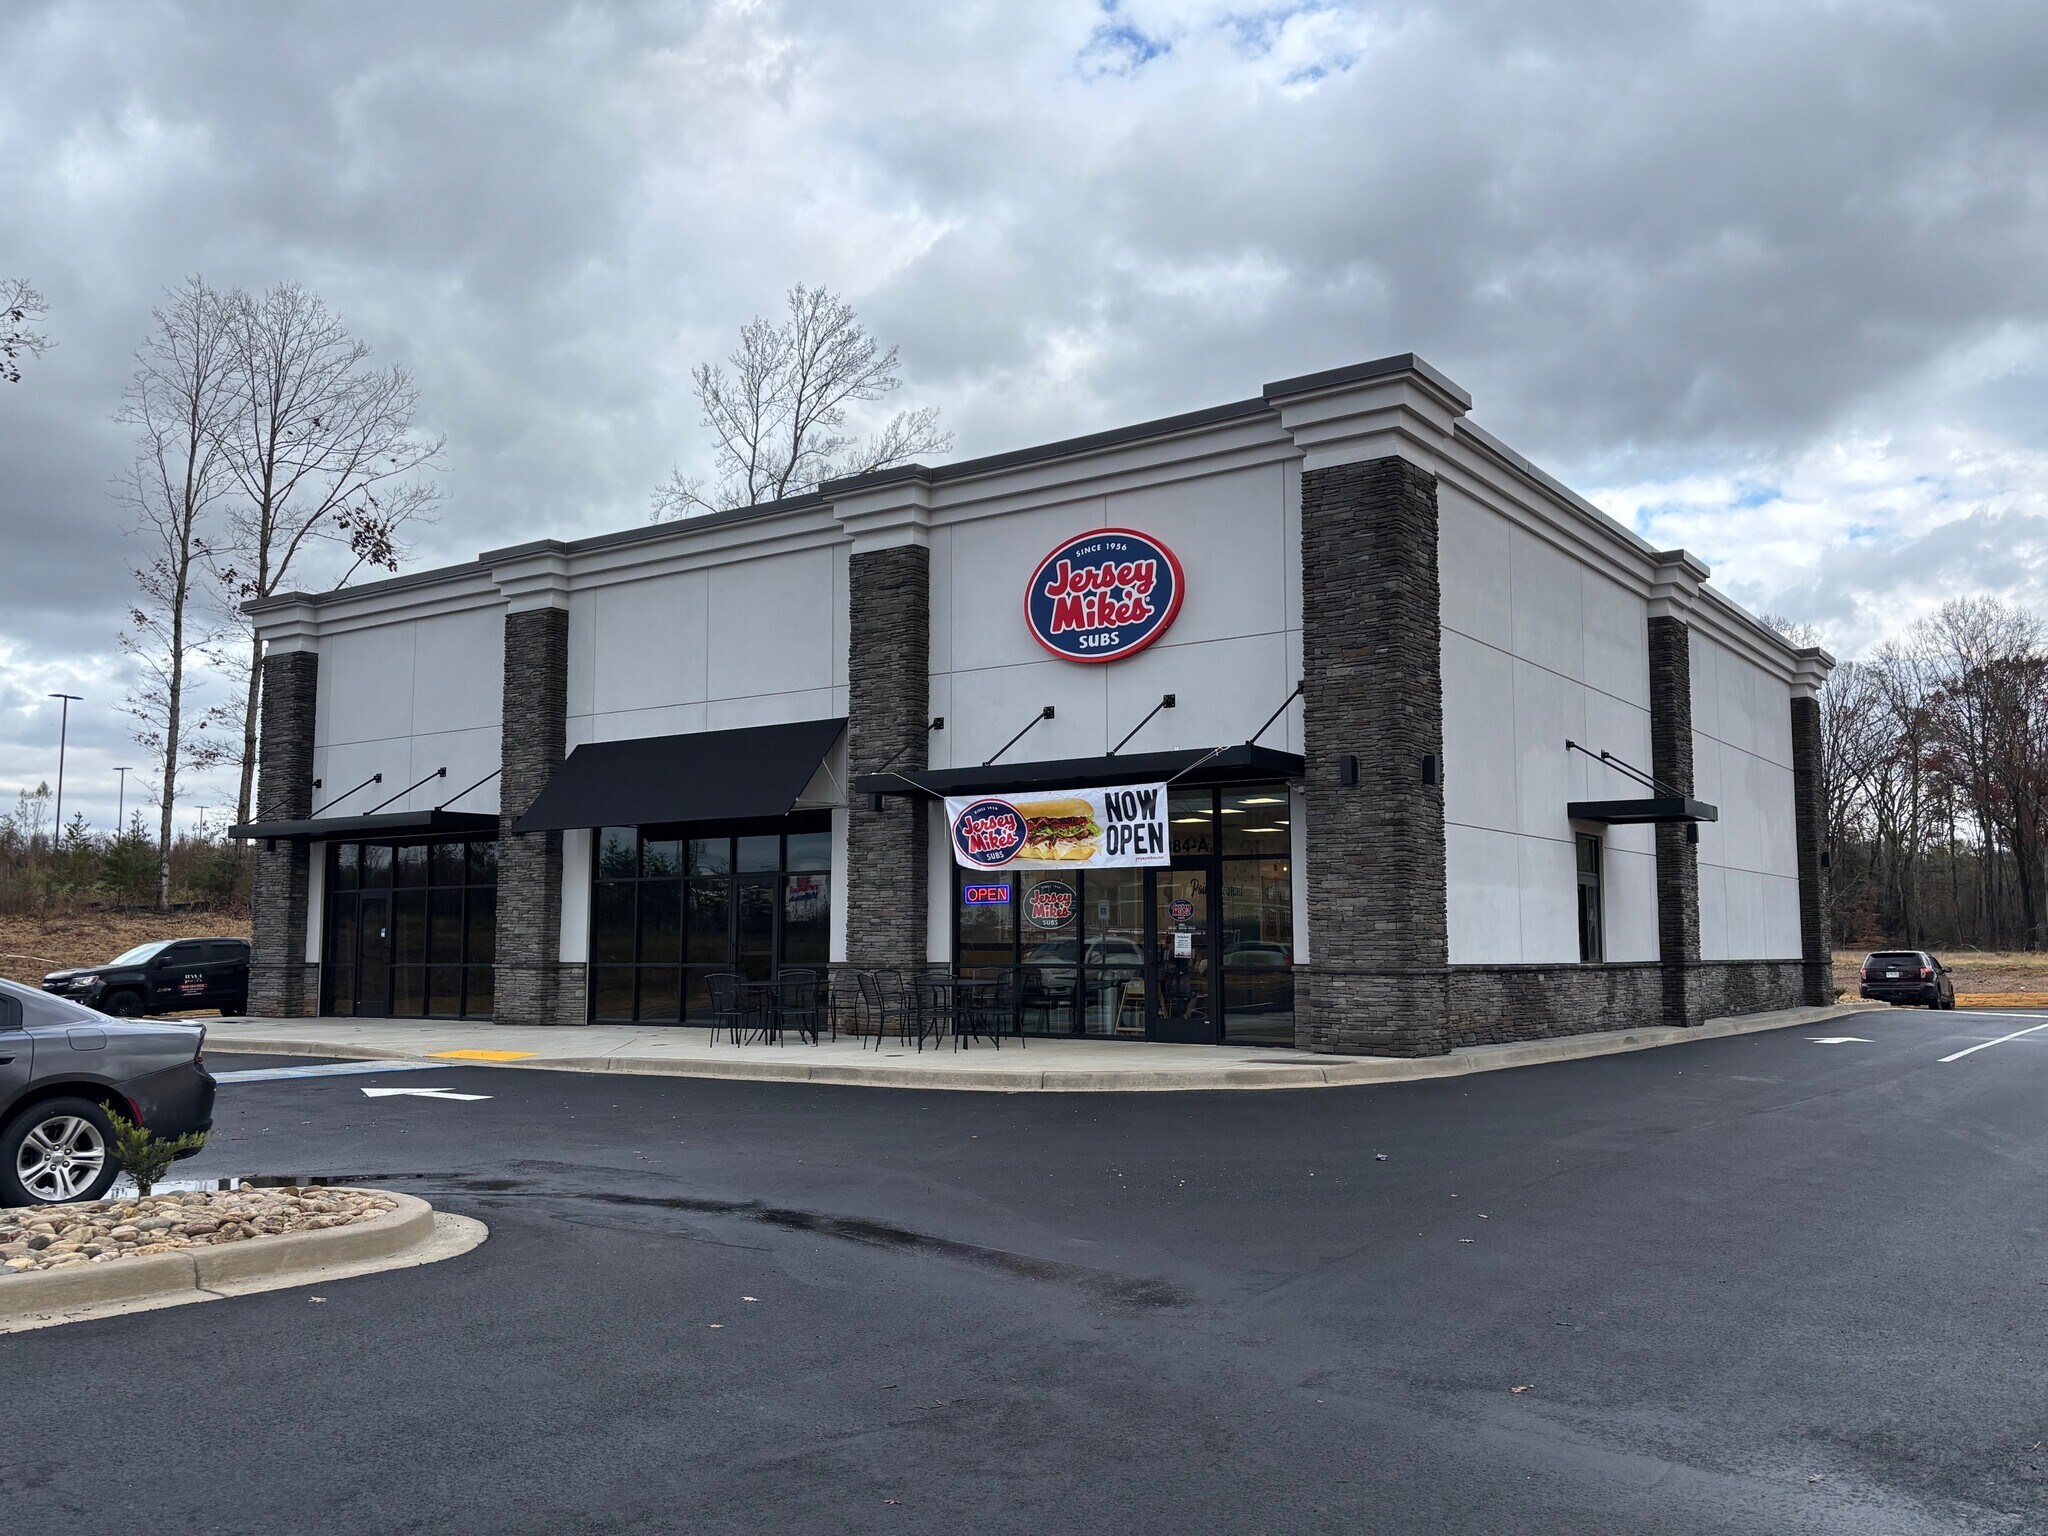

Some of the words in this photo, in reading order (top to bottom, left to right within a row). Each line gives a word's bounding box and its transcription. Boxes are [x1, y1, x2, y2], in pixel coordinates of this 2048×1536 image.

[1076, 544, 1101, 557] SINCE
[1045, 559, 1156, 597] Jersey
[1050, 590, 1155, 634] Mike's
[1079, 632, 1119, 648] SUBS
[1105, 789, 1158, 822] NOW
[962, 814, 1017, 836] Jersey
[1106, 822, 1163, 855] OPEN
[1168, 837, 1209, 854] 84-A
[986, 851, 1004, 861] SUBS
[967, 888, 1007, 901] OPEN
[1030, 890, 1072, 907] Jersey
